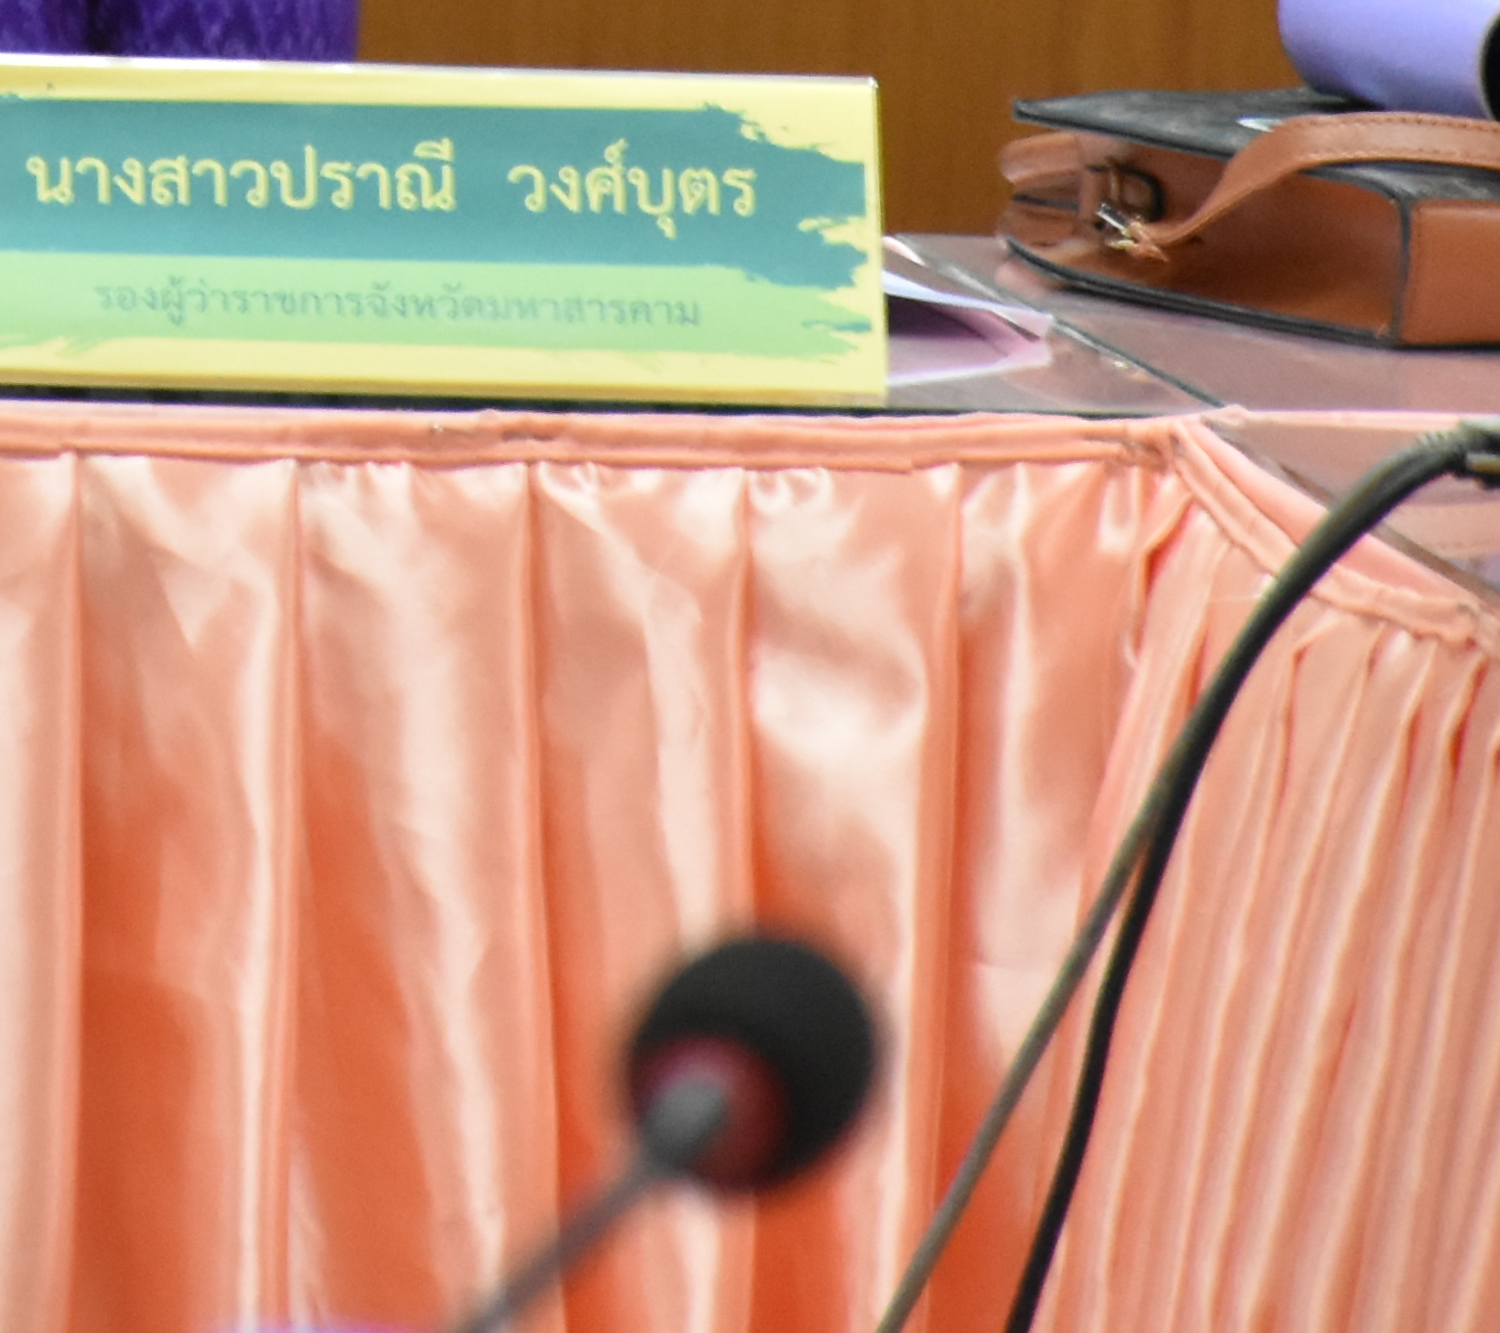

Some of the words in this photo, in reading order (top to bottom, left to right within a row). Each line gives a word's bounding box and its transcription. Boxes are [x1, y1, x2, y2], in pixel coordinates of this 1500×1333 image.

[25, 136, 457, 212] นางสาวปราณี
[506, 137, 758, 240] วงศ์บุตร
